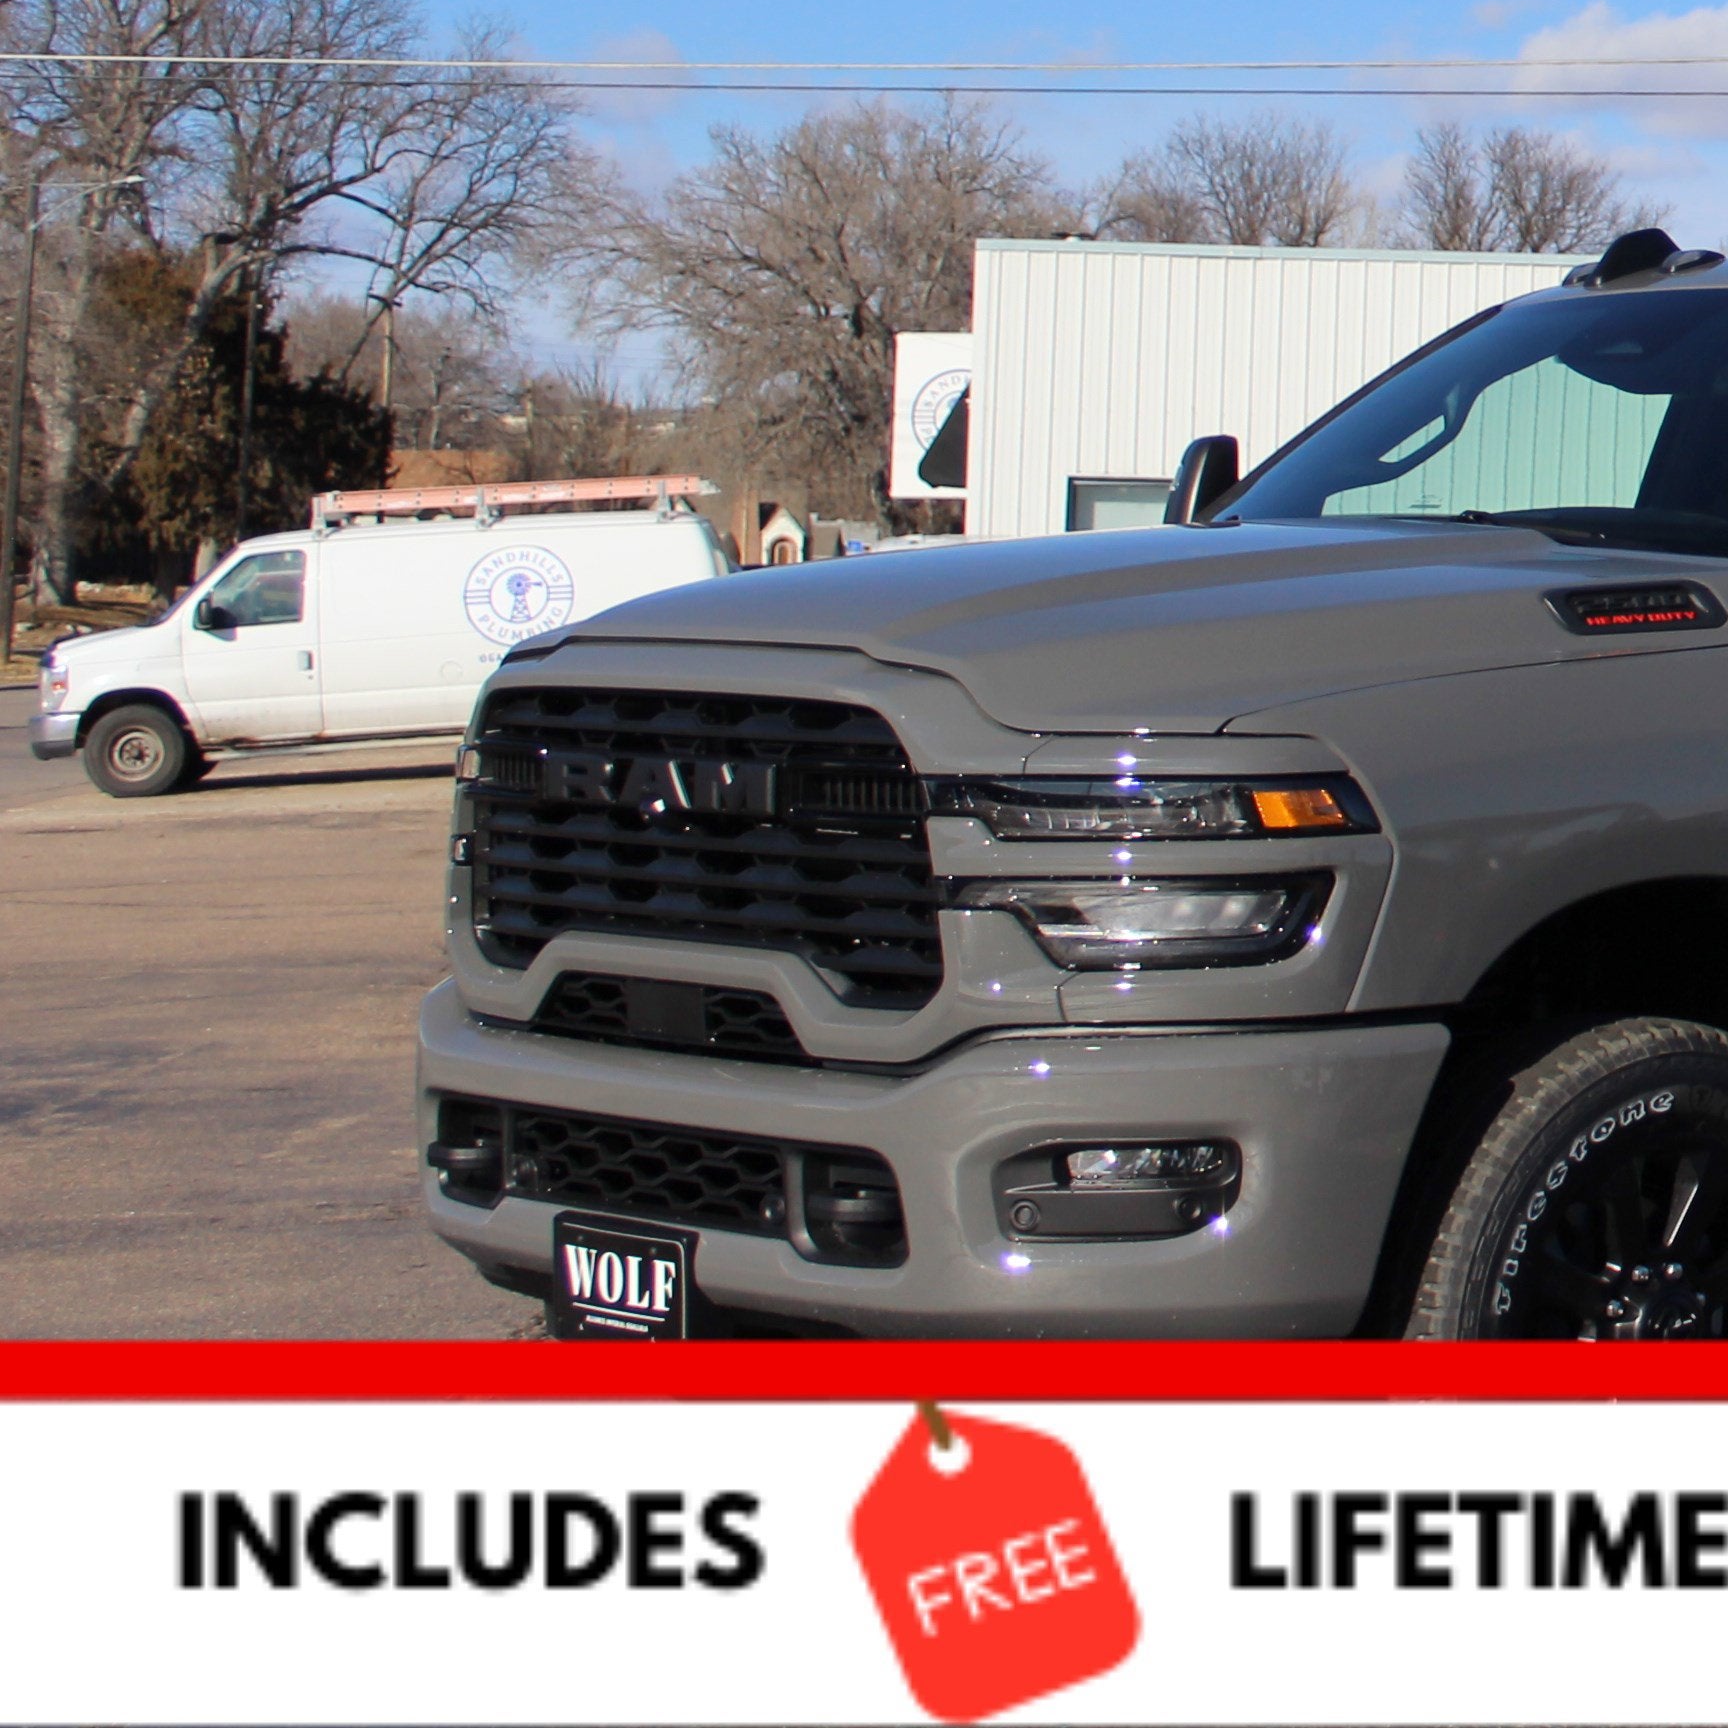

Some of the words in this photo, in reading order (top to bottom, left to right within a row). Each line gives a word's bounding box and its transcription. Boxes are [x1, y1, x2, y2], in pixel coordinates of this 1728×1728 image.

[475, 551, 564, 586] SANDHILLS
[1585, 614, 1645, 626] HEAVY
[1648, 610, 1696, 623] DUTY
[544, 753, 776, 814] RAM
[563, 1244, 676, 1312] WOLF
